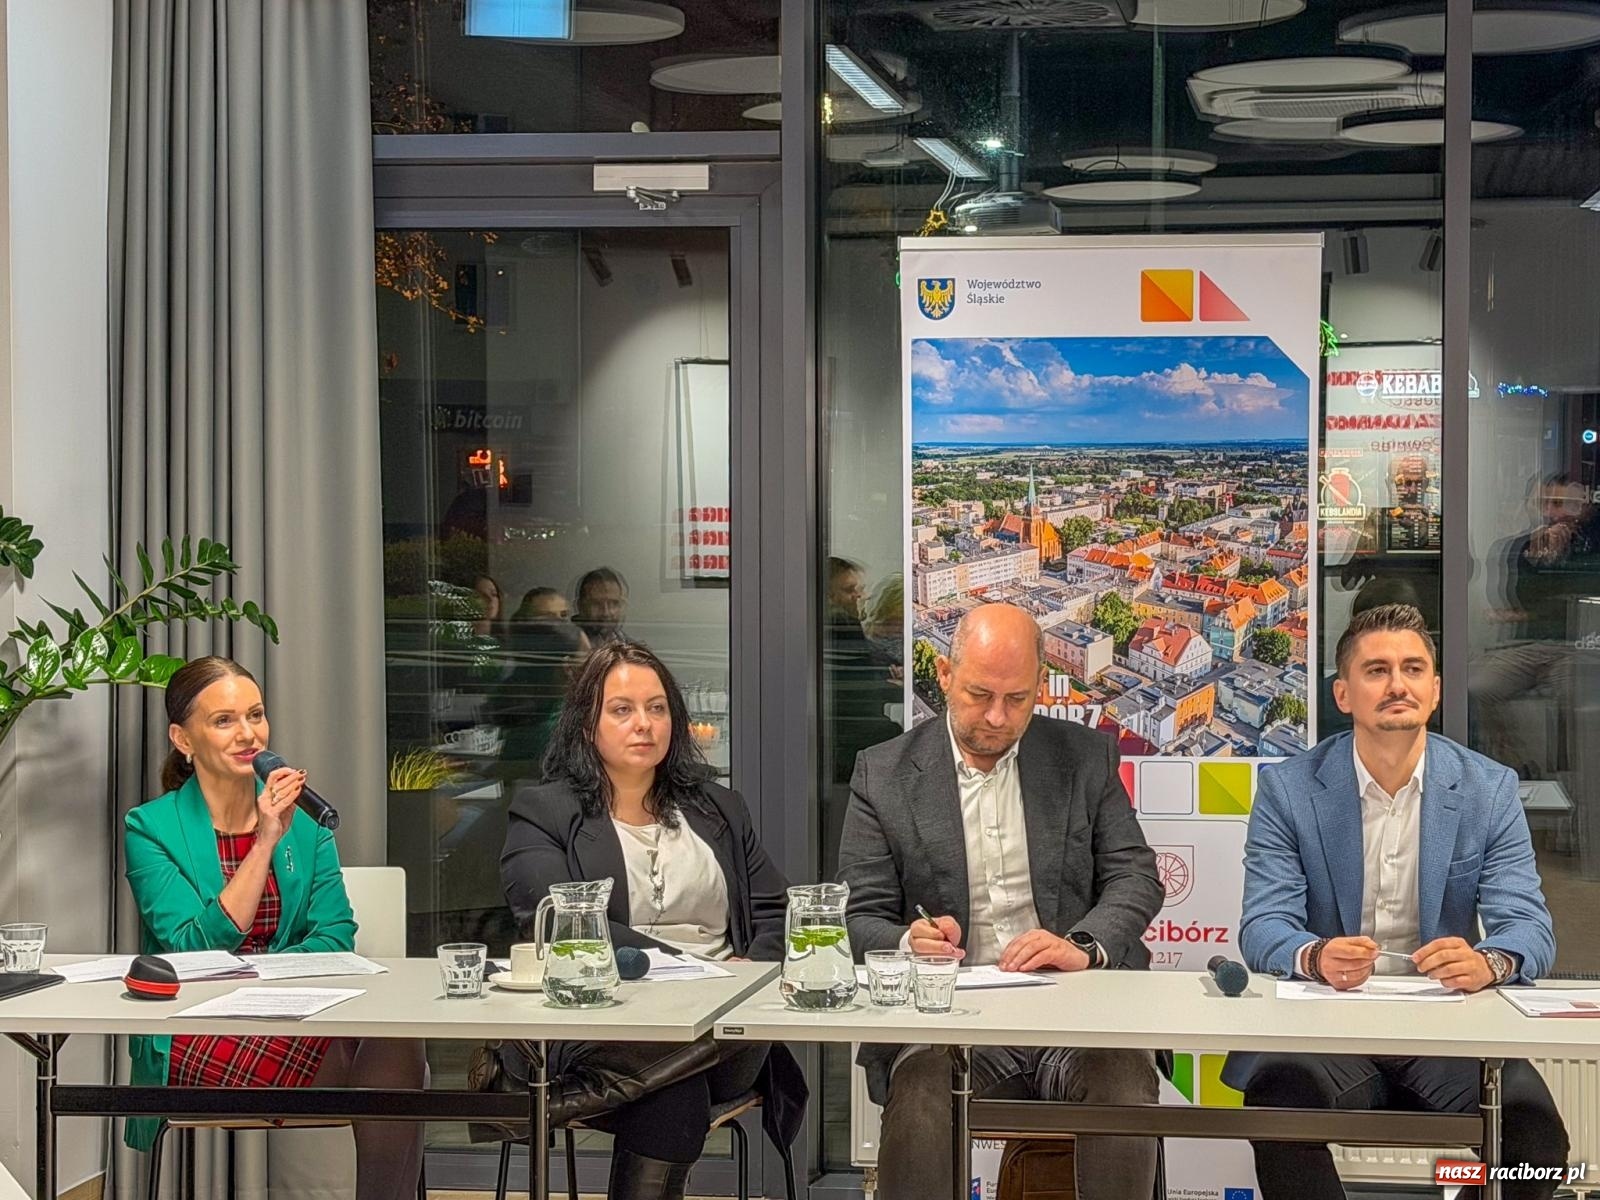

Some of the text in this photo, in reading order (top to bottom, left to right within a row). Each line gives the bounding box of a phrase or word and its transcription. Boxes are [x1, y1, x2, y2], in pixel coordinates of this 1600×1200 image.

[967, 279, 1042, 291] Województwo
[967, 293, 1005, 305] Śląskie
[454, 410, 523, 429] bitcoin
[1048, 669, 1069, 697] in
[1144, 920, 1229, 943] cibórz
